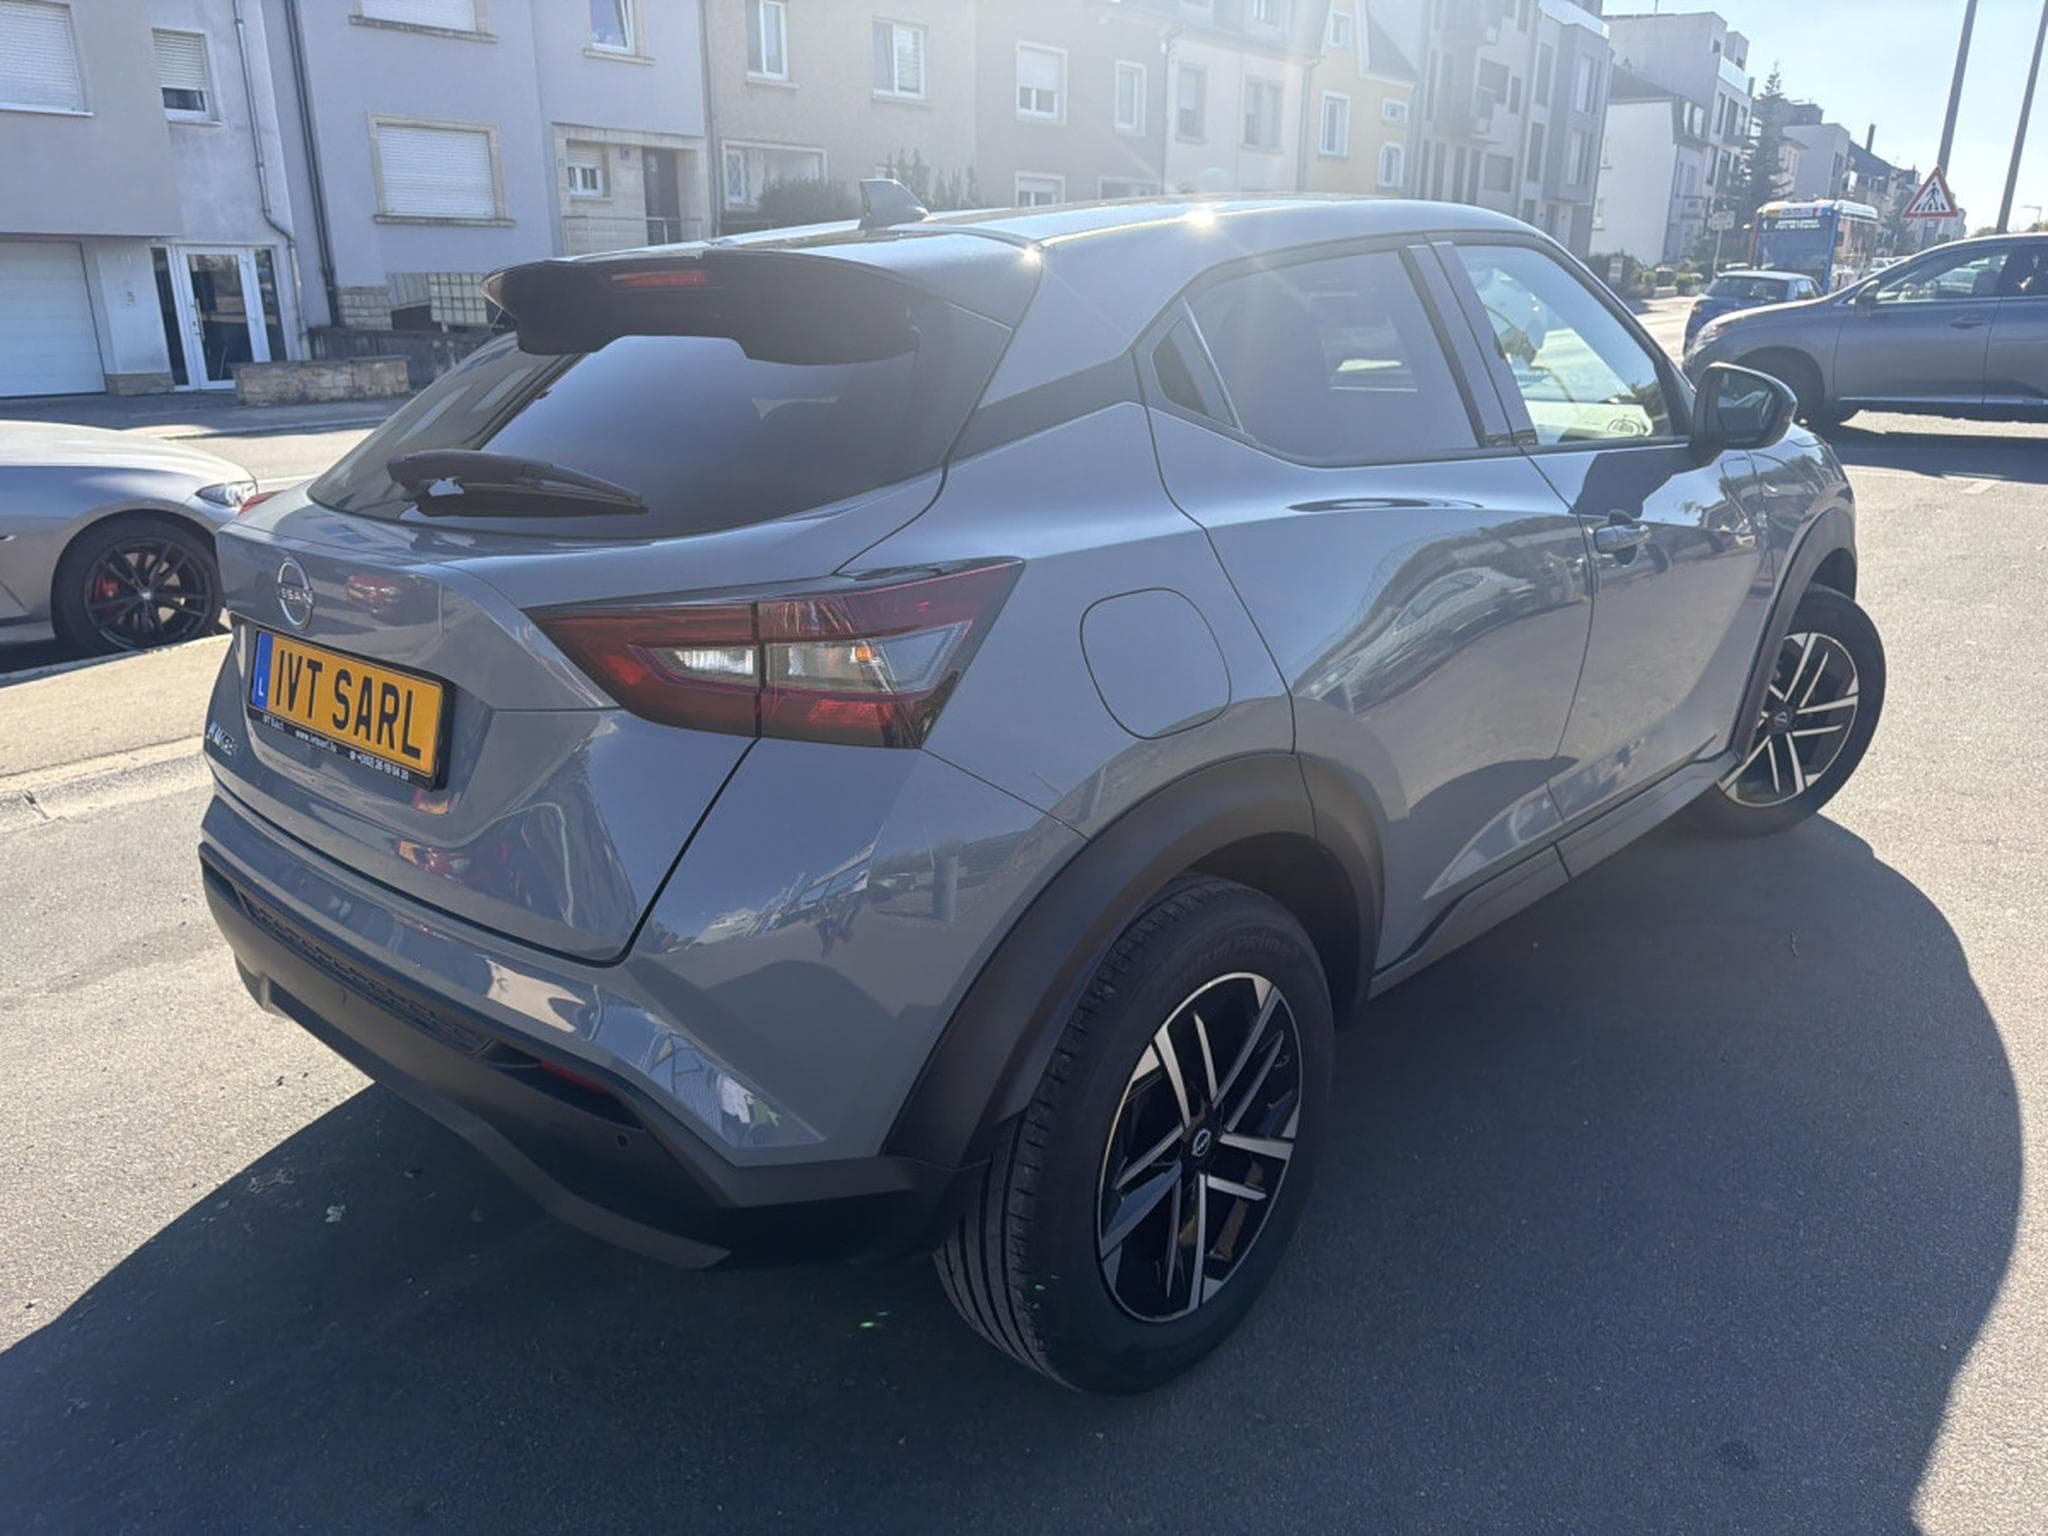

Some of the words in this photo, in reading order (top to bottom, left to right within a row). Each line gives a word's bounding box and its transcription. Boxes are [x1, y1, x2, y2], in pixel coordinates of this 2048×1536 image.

[258, 678, 264, 697] L
[276, 650, 323, 719] IVT
[332, 669, 421, 761] SARL
